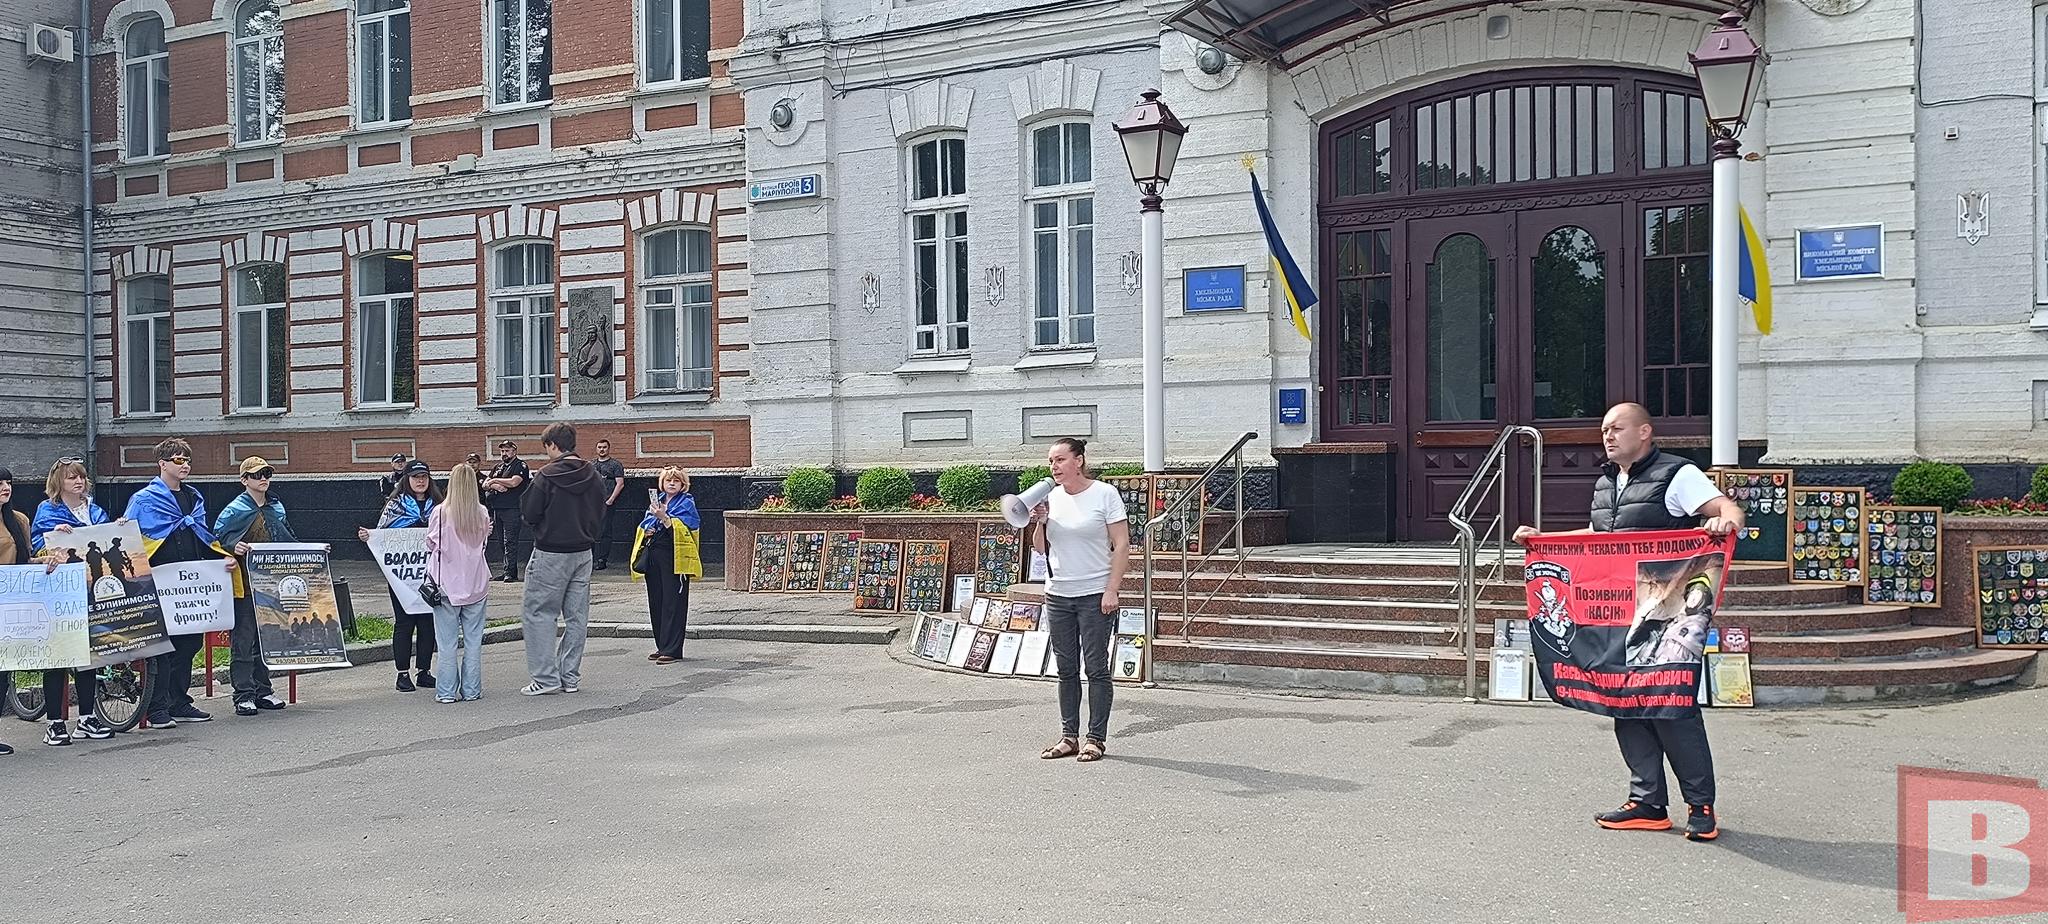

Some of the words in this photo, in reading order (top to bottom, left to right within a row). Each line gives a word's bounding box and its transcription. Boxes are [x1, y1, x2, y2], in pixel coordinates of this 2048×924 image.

[777, 181, 799, 190] ГЕРОЇВ
[803, 178, 812, 192] 3
[762, 188, 799, 197] МАРІУПОЛЯ
[1803, 249, 1846, 257] ВИКОНАВЧИЙ
[1815, 256, 1864, 264] ХМЕЛЬНИЦЬКОЇ
[1816, 263, 1842, 272] МІСЬКОЇ
[1844, 263, 1863, 271] РАДИ
[1588, 542, 1631, 556] ЧЕКАЄМО
[1631, 541, 1657, 554] ТЕБЕ
[252, 554, 265, 563] МИ
[265, 554, 275, 563] НЕ
[178, 570, 199, 581] Без
[157, 582, 223, 597] волонтерів
[174, 599, 211, 609] важче
[121, 612, 144, 621] фронту
[173, 609, 218, 625] фронту!
[1584, 605, 1626, 620] «КАСІК»
[14, 645, 52, 658] ХОЧЕМО
[17, 657, 76, 670] КОРИСНИМИ
